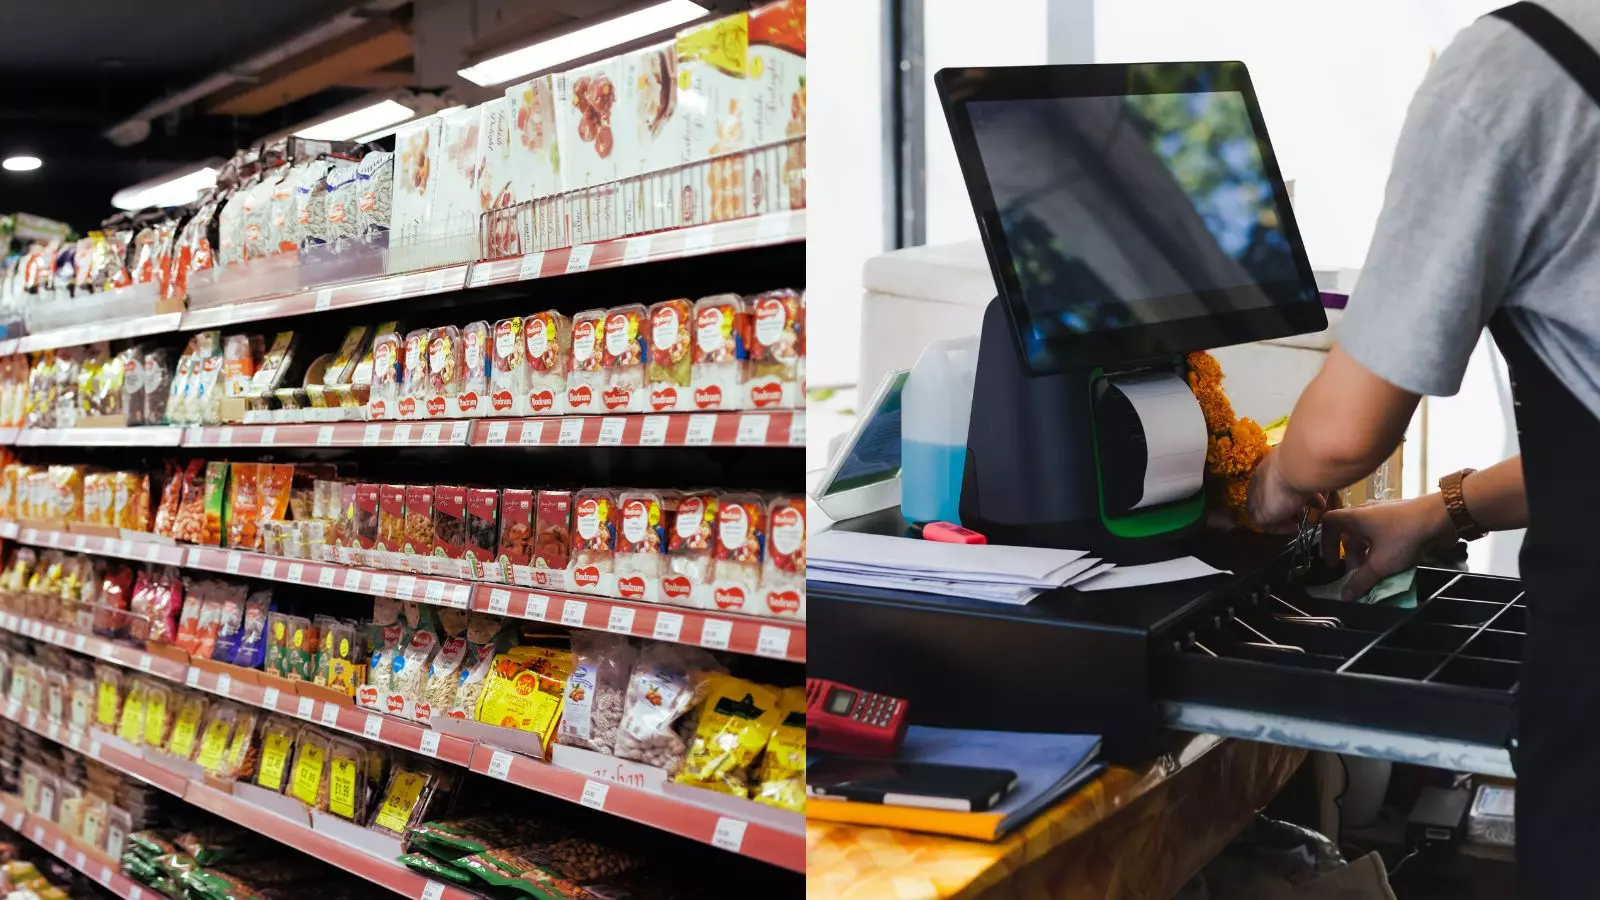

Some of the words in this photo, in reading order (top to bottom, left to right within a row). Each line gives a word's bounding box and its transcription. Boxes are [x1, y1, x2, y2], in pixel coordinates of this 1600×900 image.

[488, 112, 497, 152] Delight
[493, 397, 512, 405] Bodrum
[531, 396, 552, 405] Bodrum
[569, 392, 591, 401] Bodrum
[604, 395, 628, 403] Bodrum
[651, 395, 676, 404] Bodrum
[696, 393, 720, 402] Bodrum
[427, 402, 444, 411] Bodrum
[459, 398, 477, 406] Bodrum
[575, 571, 599, 581] Bodrum
[619, 582, 645, 592] Bodrum
[664, 582, 690, 592] Bodrum
[716, 593, 744, 604] Bodrum
[769, 598, 798, 608] Bodrum
